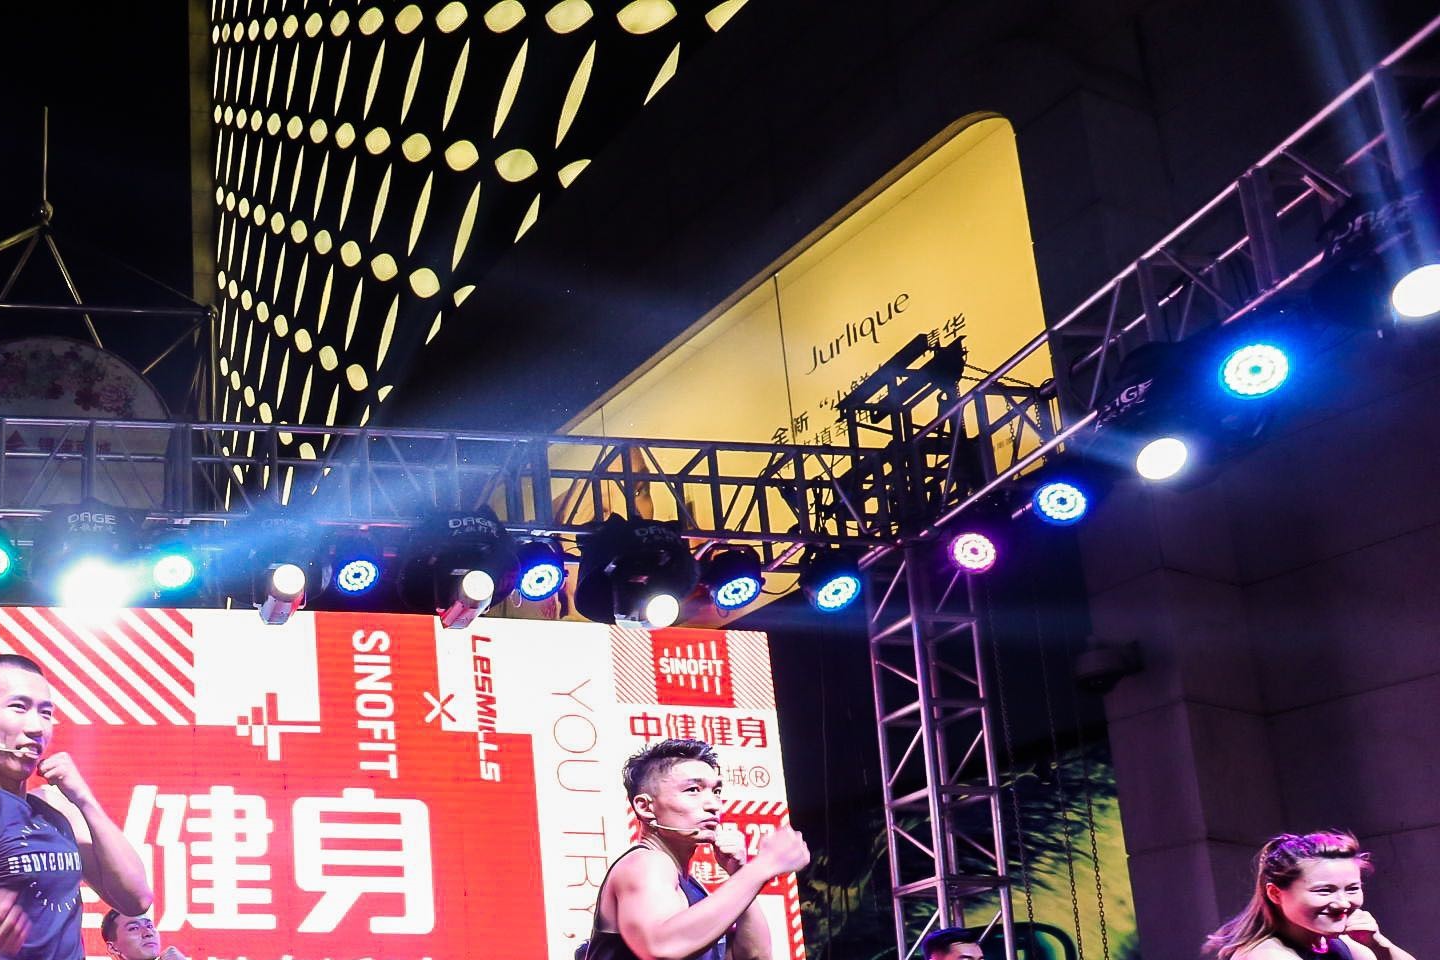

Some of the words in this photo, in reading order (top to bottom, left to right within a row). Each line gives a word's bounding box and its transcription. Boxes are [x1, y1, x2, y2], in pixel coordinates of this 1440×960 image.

[805, 293, 909, 376] Jurlique
[352, 628, 399, 780] SINOFIT
[659, 656, 724, 677] SINOFIT
[551, 678, 602, 793] YOU
[628, 711, 769, 749] 中健健身
